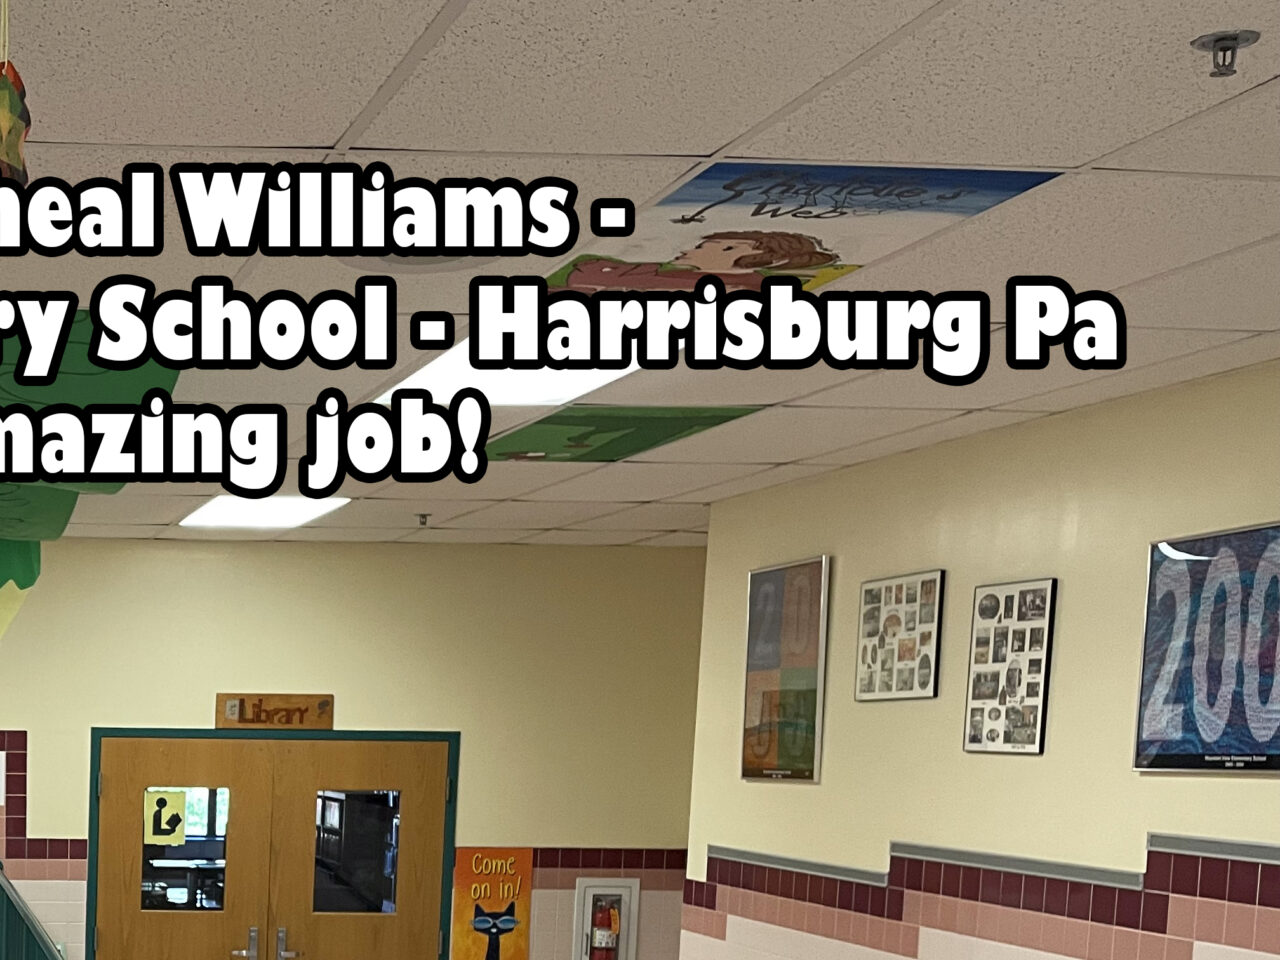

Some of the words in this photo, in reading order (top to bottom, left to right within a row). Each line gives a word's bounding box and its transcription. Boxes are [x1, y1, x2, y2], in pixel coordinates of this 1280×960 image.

[472, 853, 516, 875] Come
[471, 883, 490, 900] on
[499, 875, 521, 900] in!
